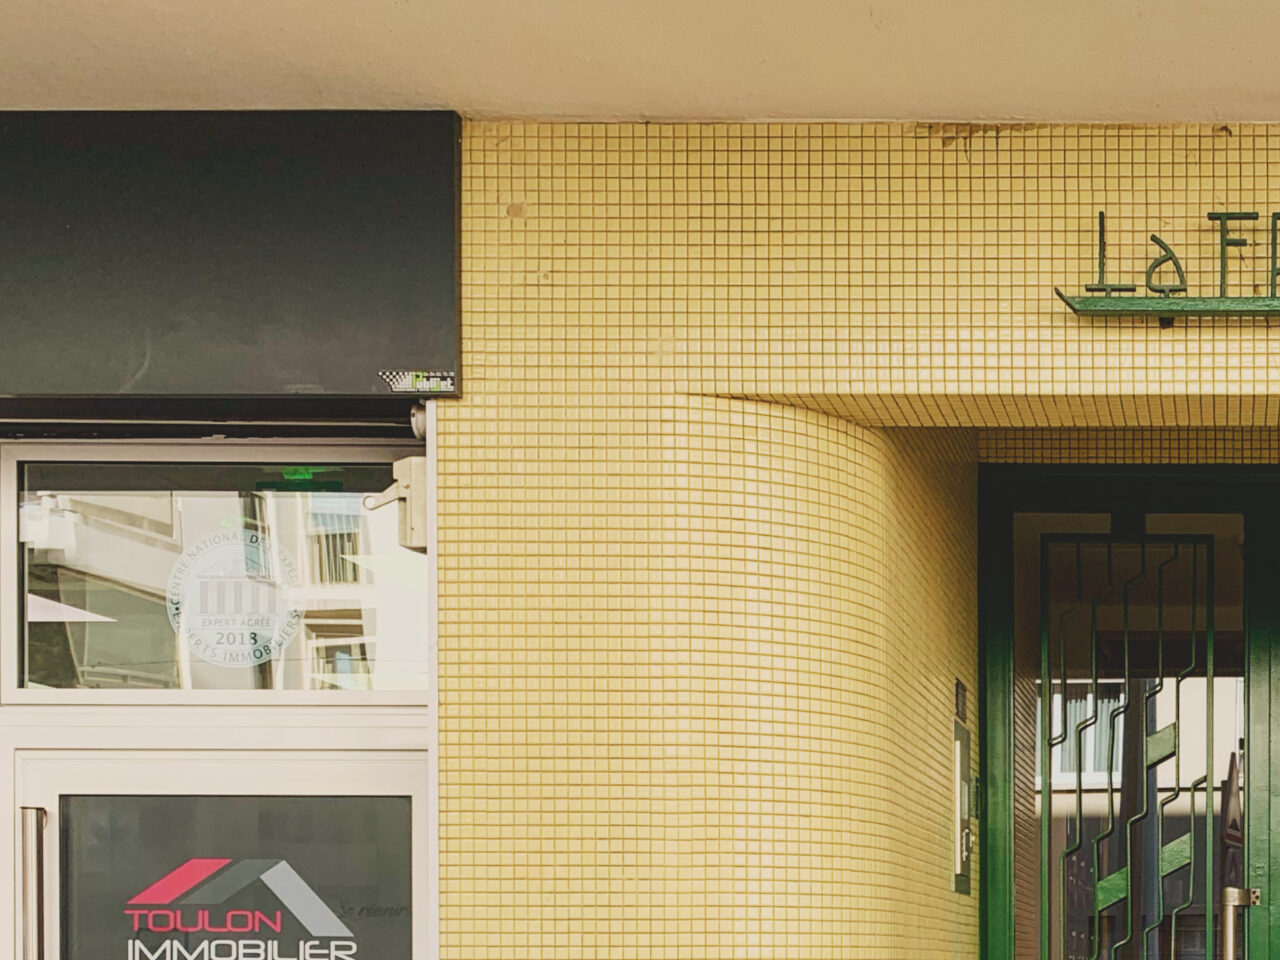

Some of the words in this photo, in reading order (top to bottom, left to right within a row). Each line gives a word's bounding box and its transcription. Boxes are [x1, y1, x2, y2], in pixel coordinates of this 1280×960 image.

[1085, 210, 1187, 296] La
[215, 631, 258, 645] 2018
[124, 909, 282, 933] TOULON
